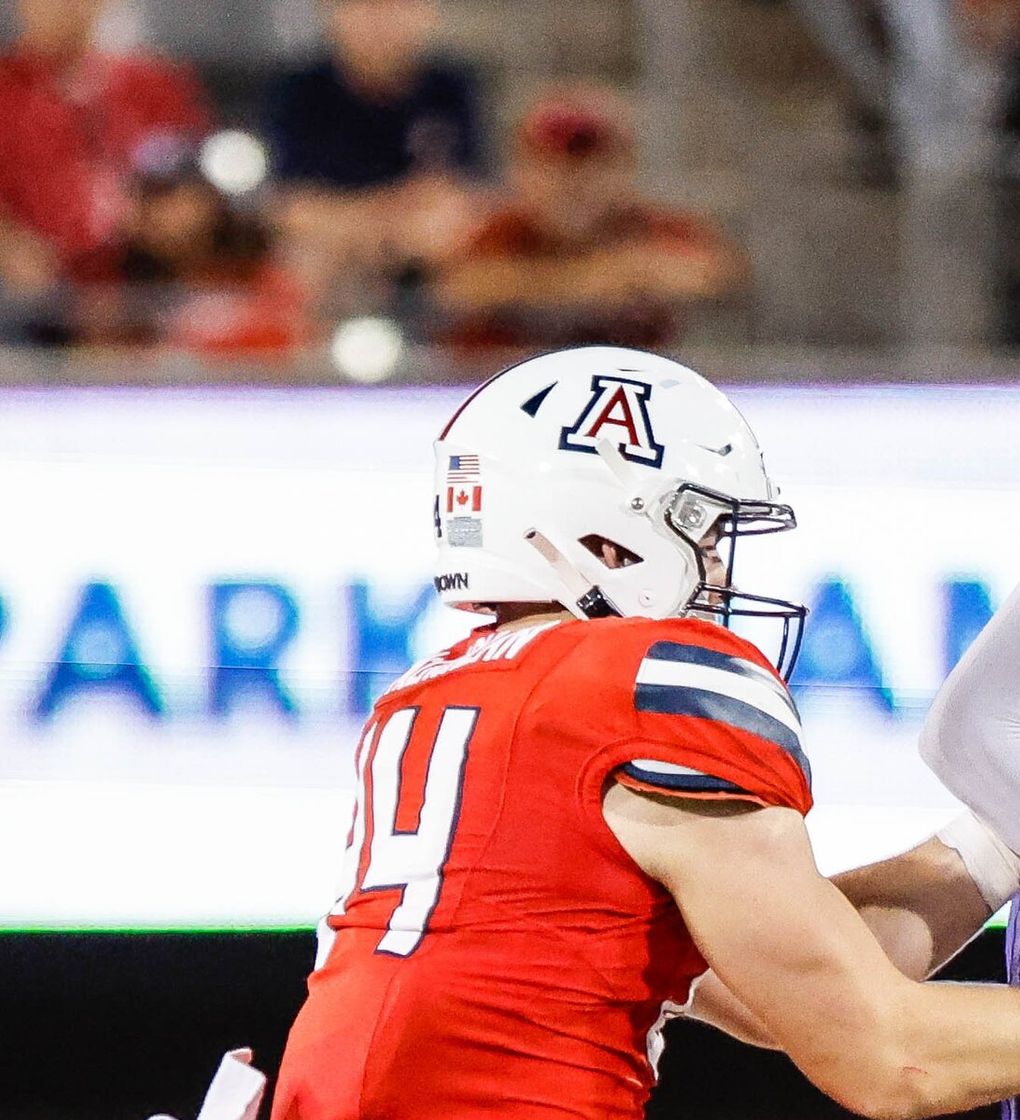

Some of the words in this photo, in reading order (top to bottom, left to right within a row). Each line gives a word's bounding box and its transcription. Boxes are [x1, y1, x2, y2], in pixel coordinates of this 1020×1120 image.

[558, 374, 665, 470] A
[0, 580, 440, 716] ARK
[314, 705, 481, 970] 4
